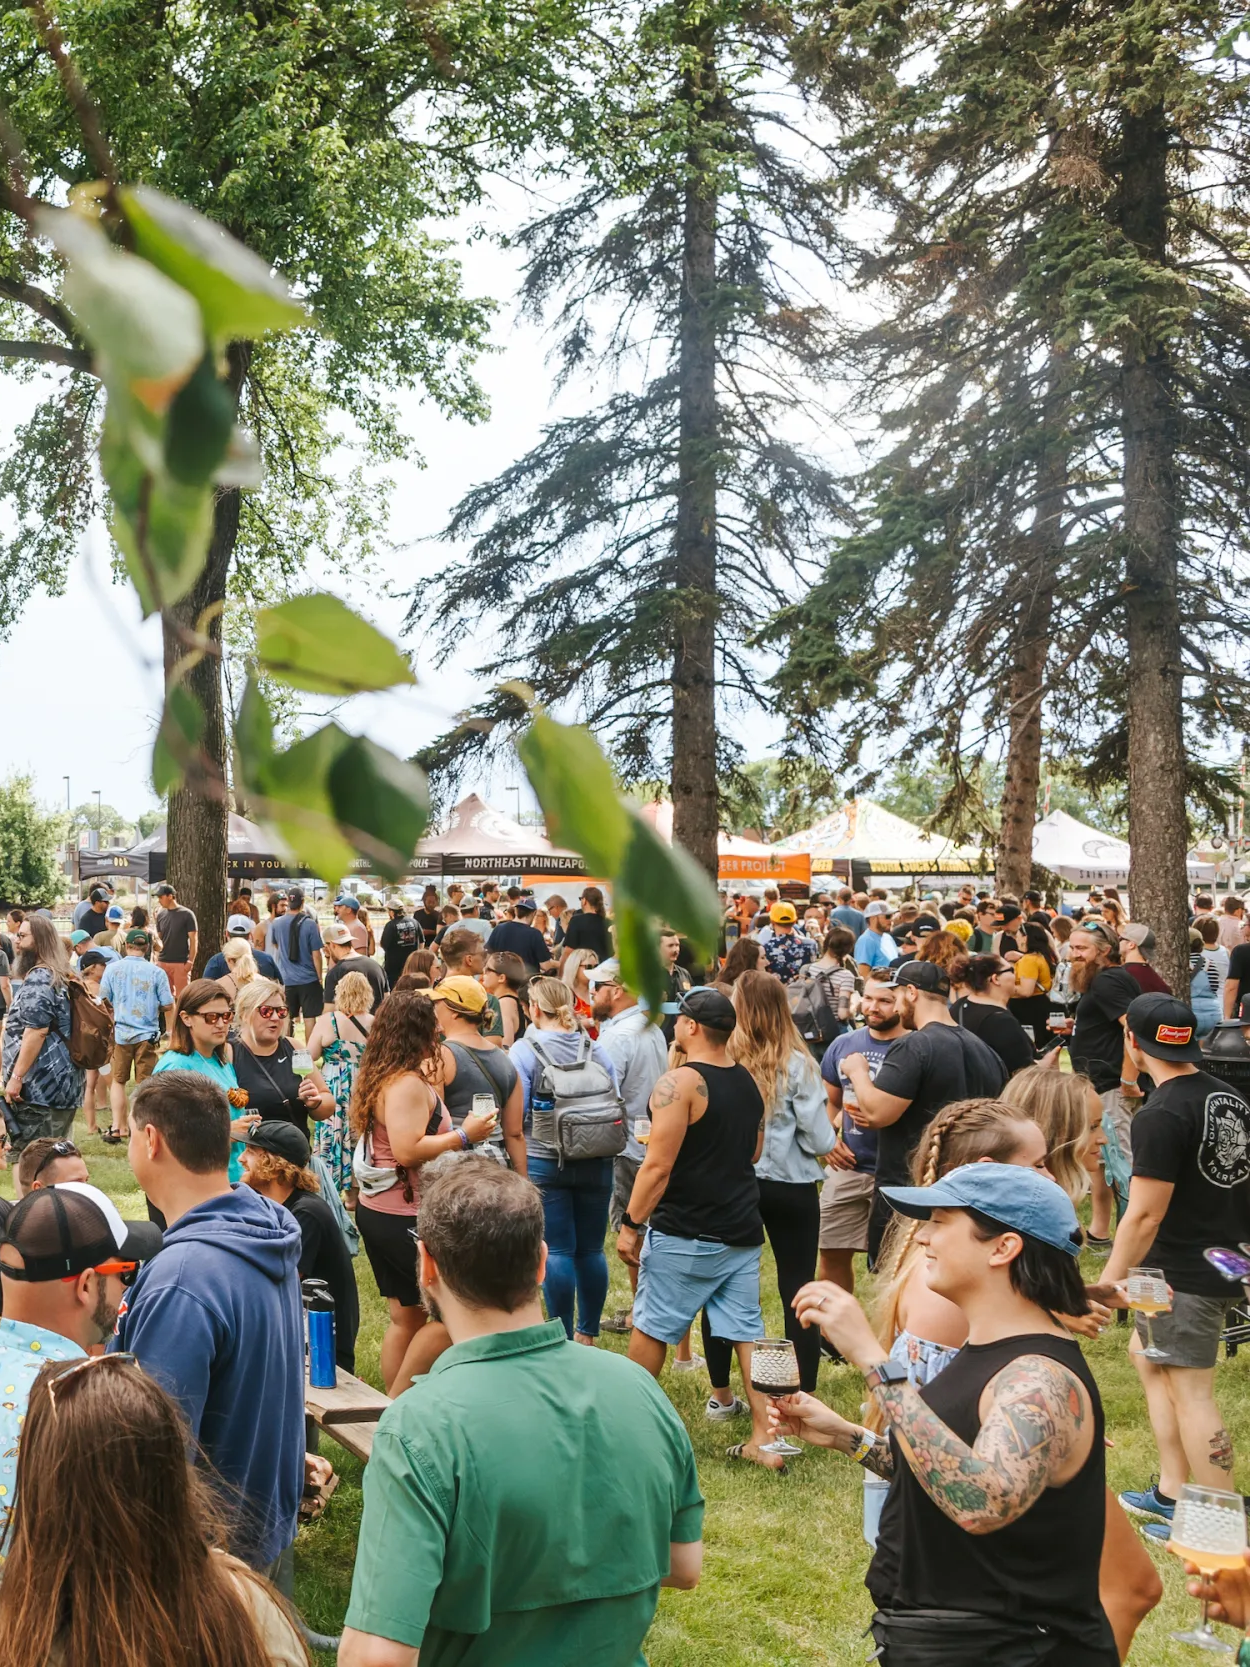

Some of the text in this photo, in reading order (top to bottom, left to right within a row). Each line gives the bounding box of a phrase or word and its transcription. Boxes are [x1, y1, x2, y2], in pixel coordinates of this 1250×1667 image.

[260, 861, 286, 869] YOUR
[464, 857, 528, 869] NORTHEAST
[718, 860, 738, 872] EER
[1079, 869, 1109, 879] SAINT
[1210, 1097, 1250, 1115] MENTALITY
